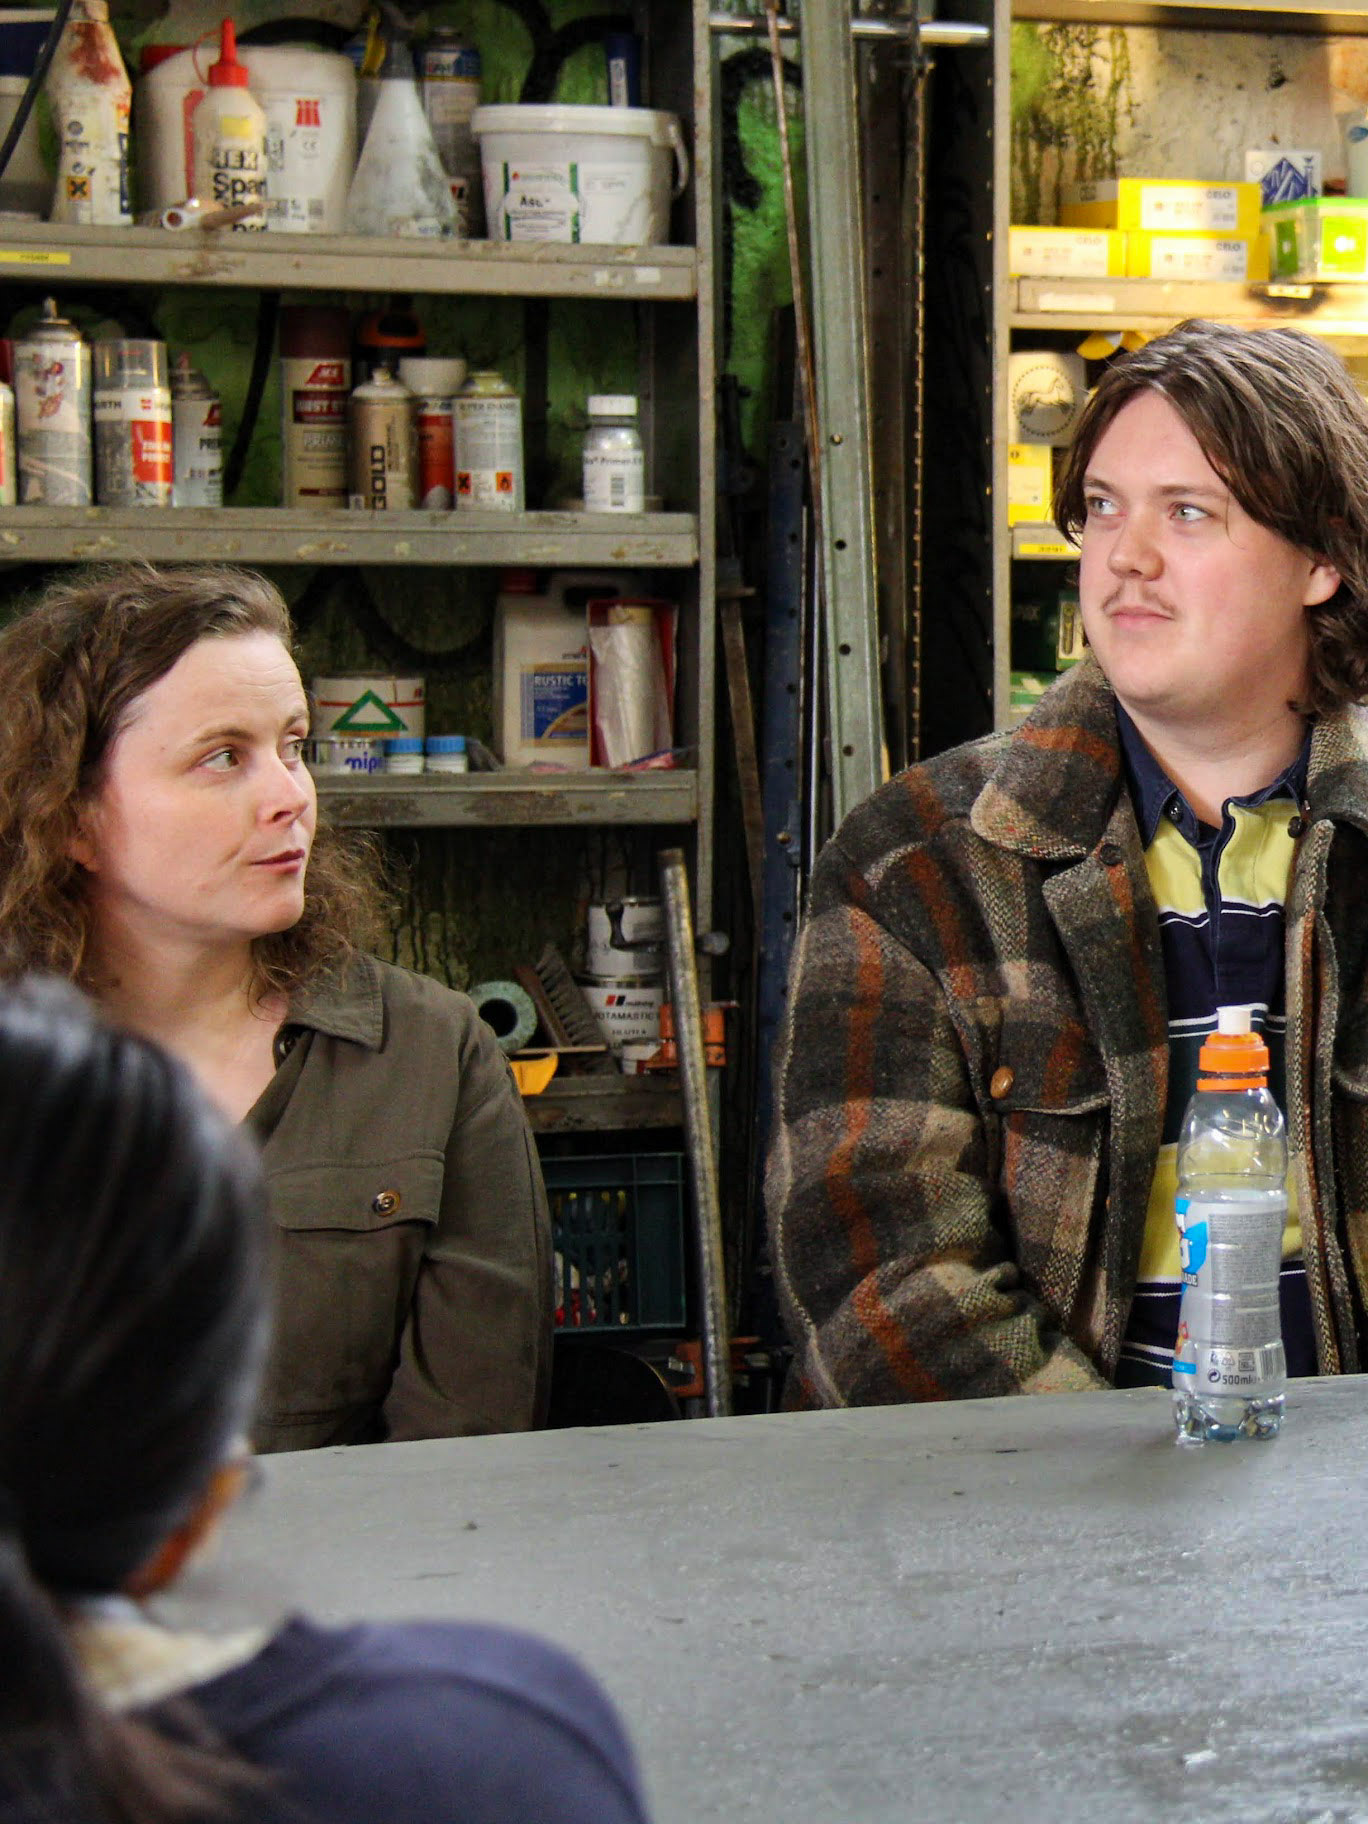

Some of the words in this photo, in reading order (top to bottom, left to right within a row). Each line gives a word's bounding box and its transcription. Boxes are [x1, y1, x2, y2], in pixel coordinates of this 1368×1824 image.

[371, 445, 387, 510] GOLD
[534, 675, 574, 687] RUSTIC
[1222, 1374, 1251, 1385] 500ml
